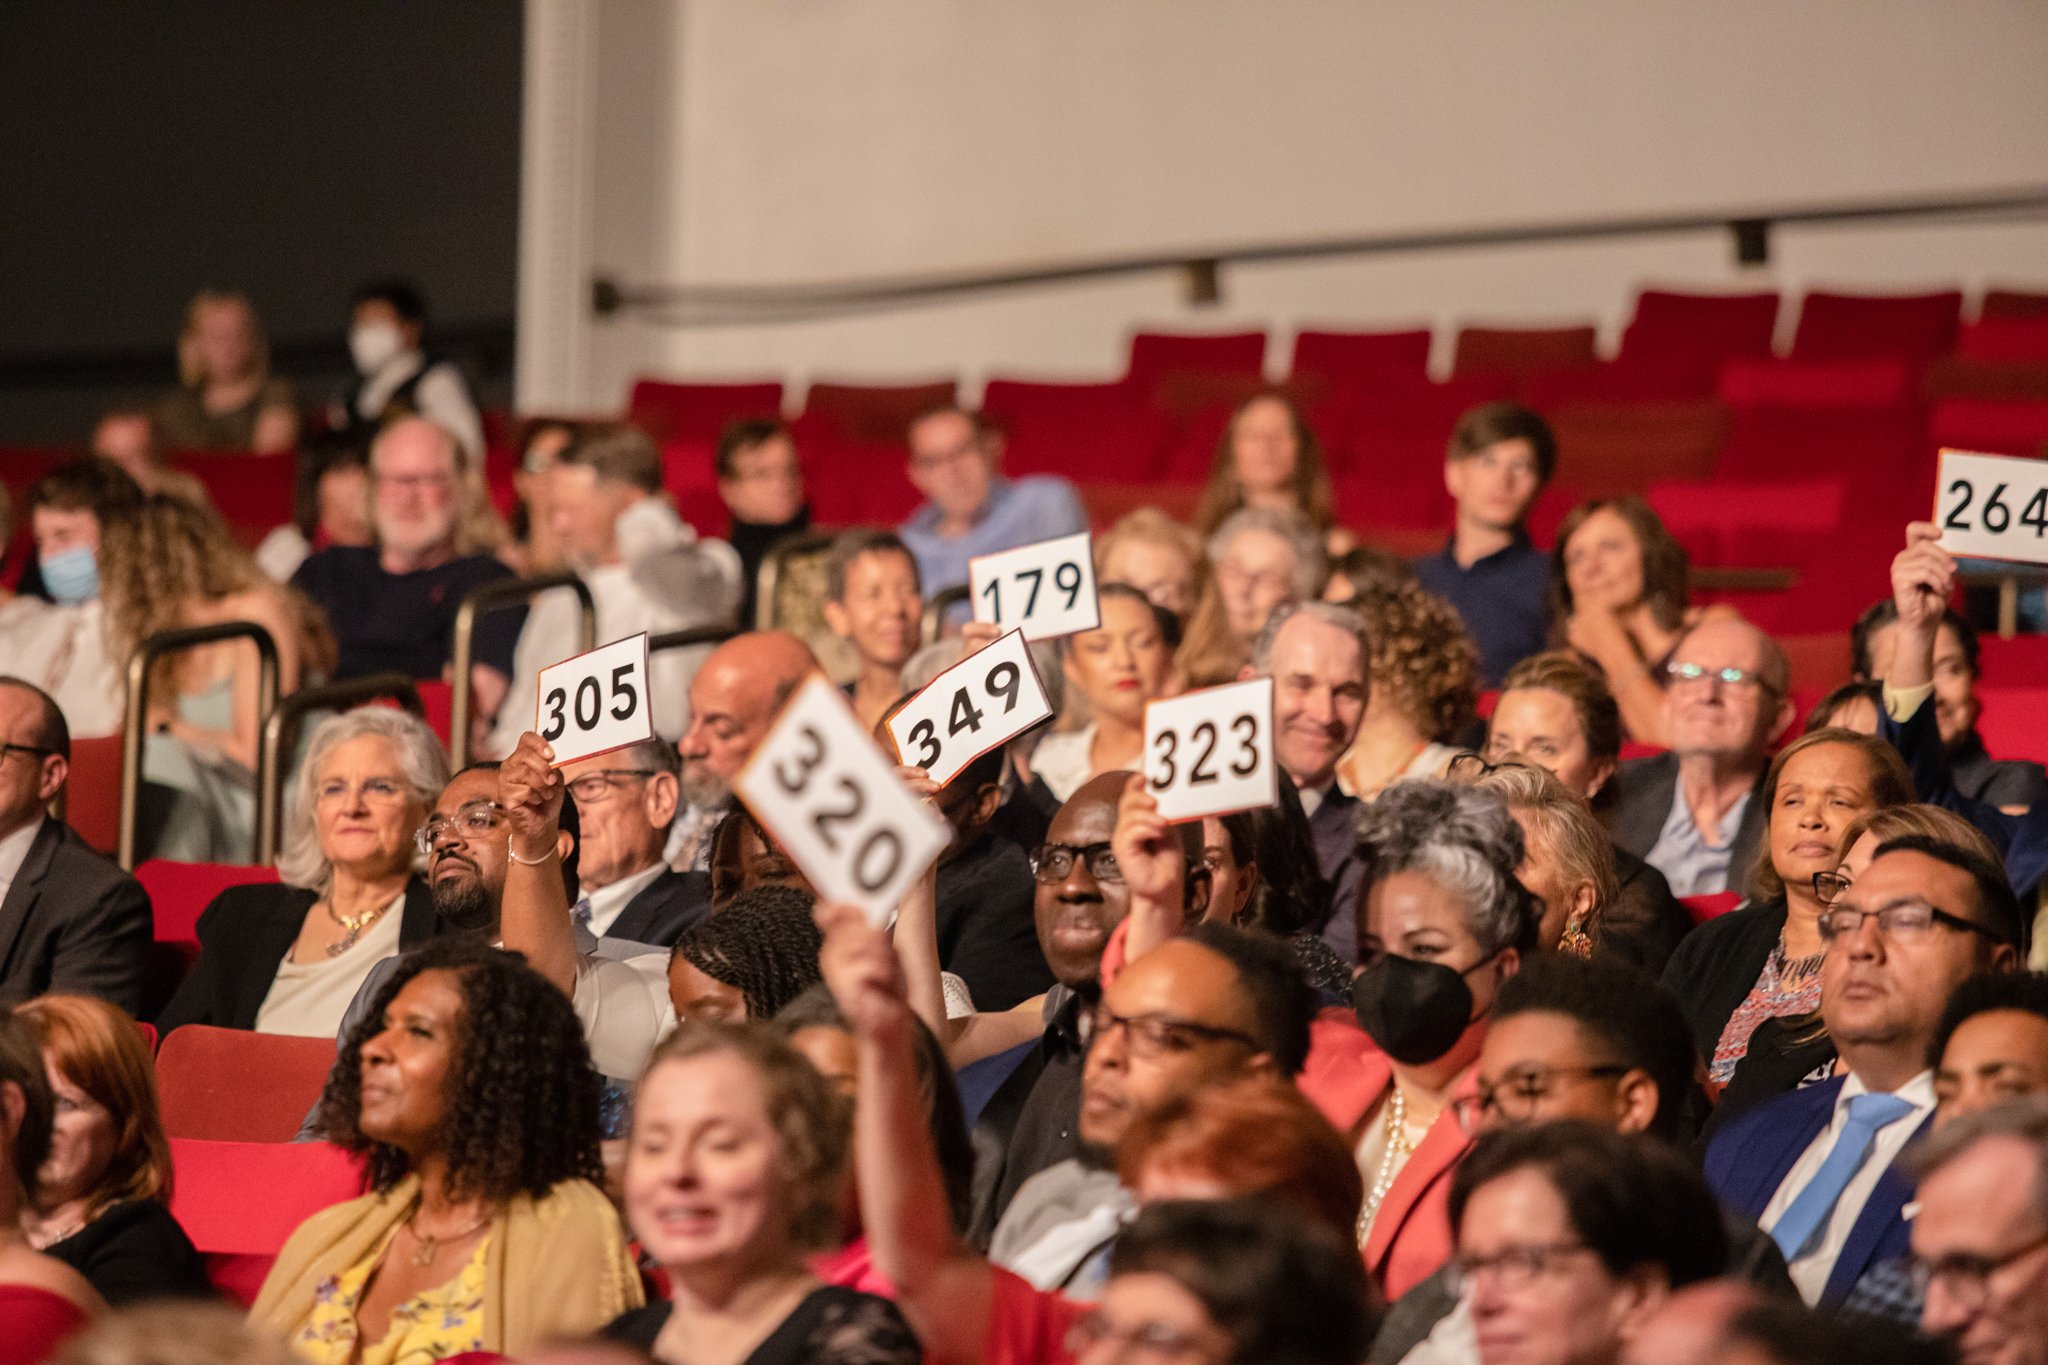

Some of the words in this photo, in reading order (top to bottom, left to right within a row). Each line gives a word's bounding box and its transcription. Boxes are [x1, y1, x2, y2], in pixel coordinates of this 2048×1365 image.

[1946, 479, 2048, 537] 264
[983, 561, 1082, 623] 179
[542, 663, 637, 742] 305
[908, 661, 1020, 769] 349
[1150, 713, 1258, 790] 323
[771, 727, 904, 893] 320
